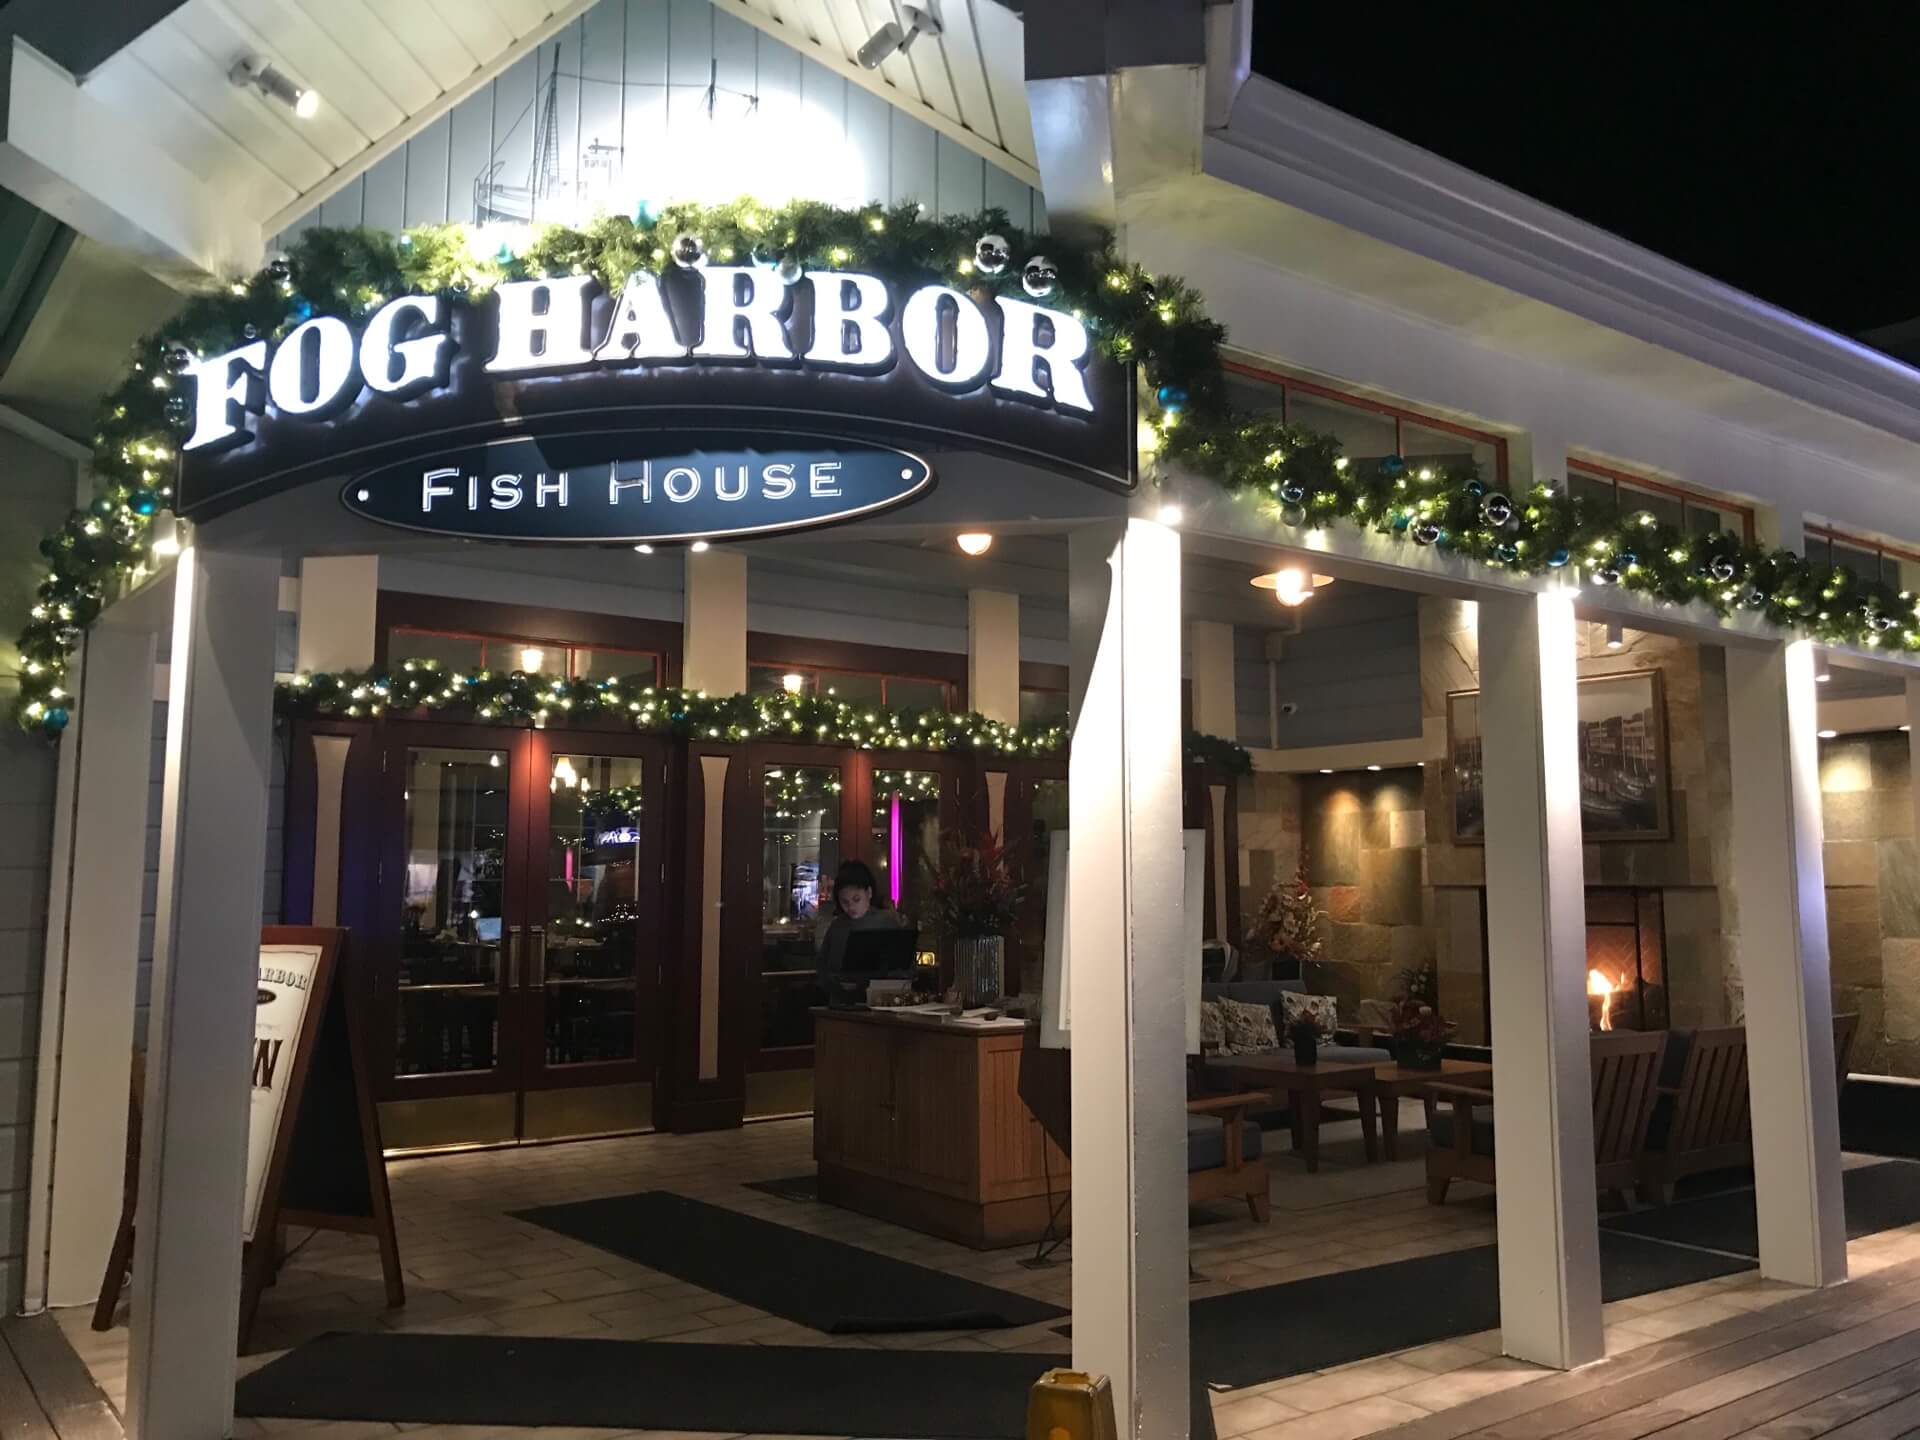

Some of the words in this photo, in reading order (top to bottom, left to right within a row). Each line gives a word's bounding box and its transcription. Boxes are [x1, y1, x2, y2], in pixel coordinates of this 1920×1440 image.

[180, 292, 447, 451] FOG
[483, 264, 1094, 412] HARBOR
[421, 467, 568, 512] FISH
[608, 459, 843, 505] HOUSE
